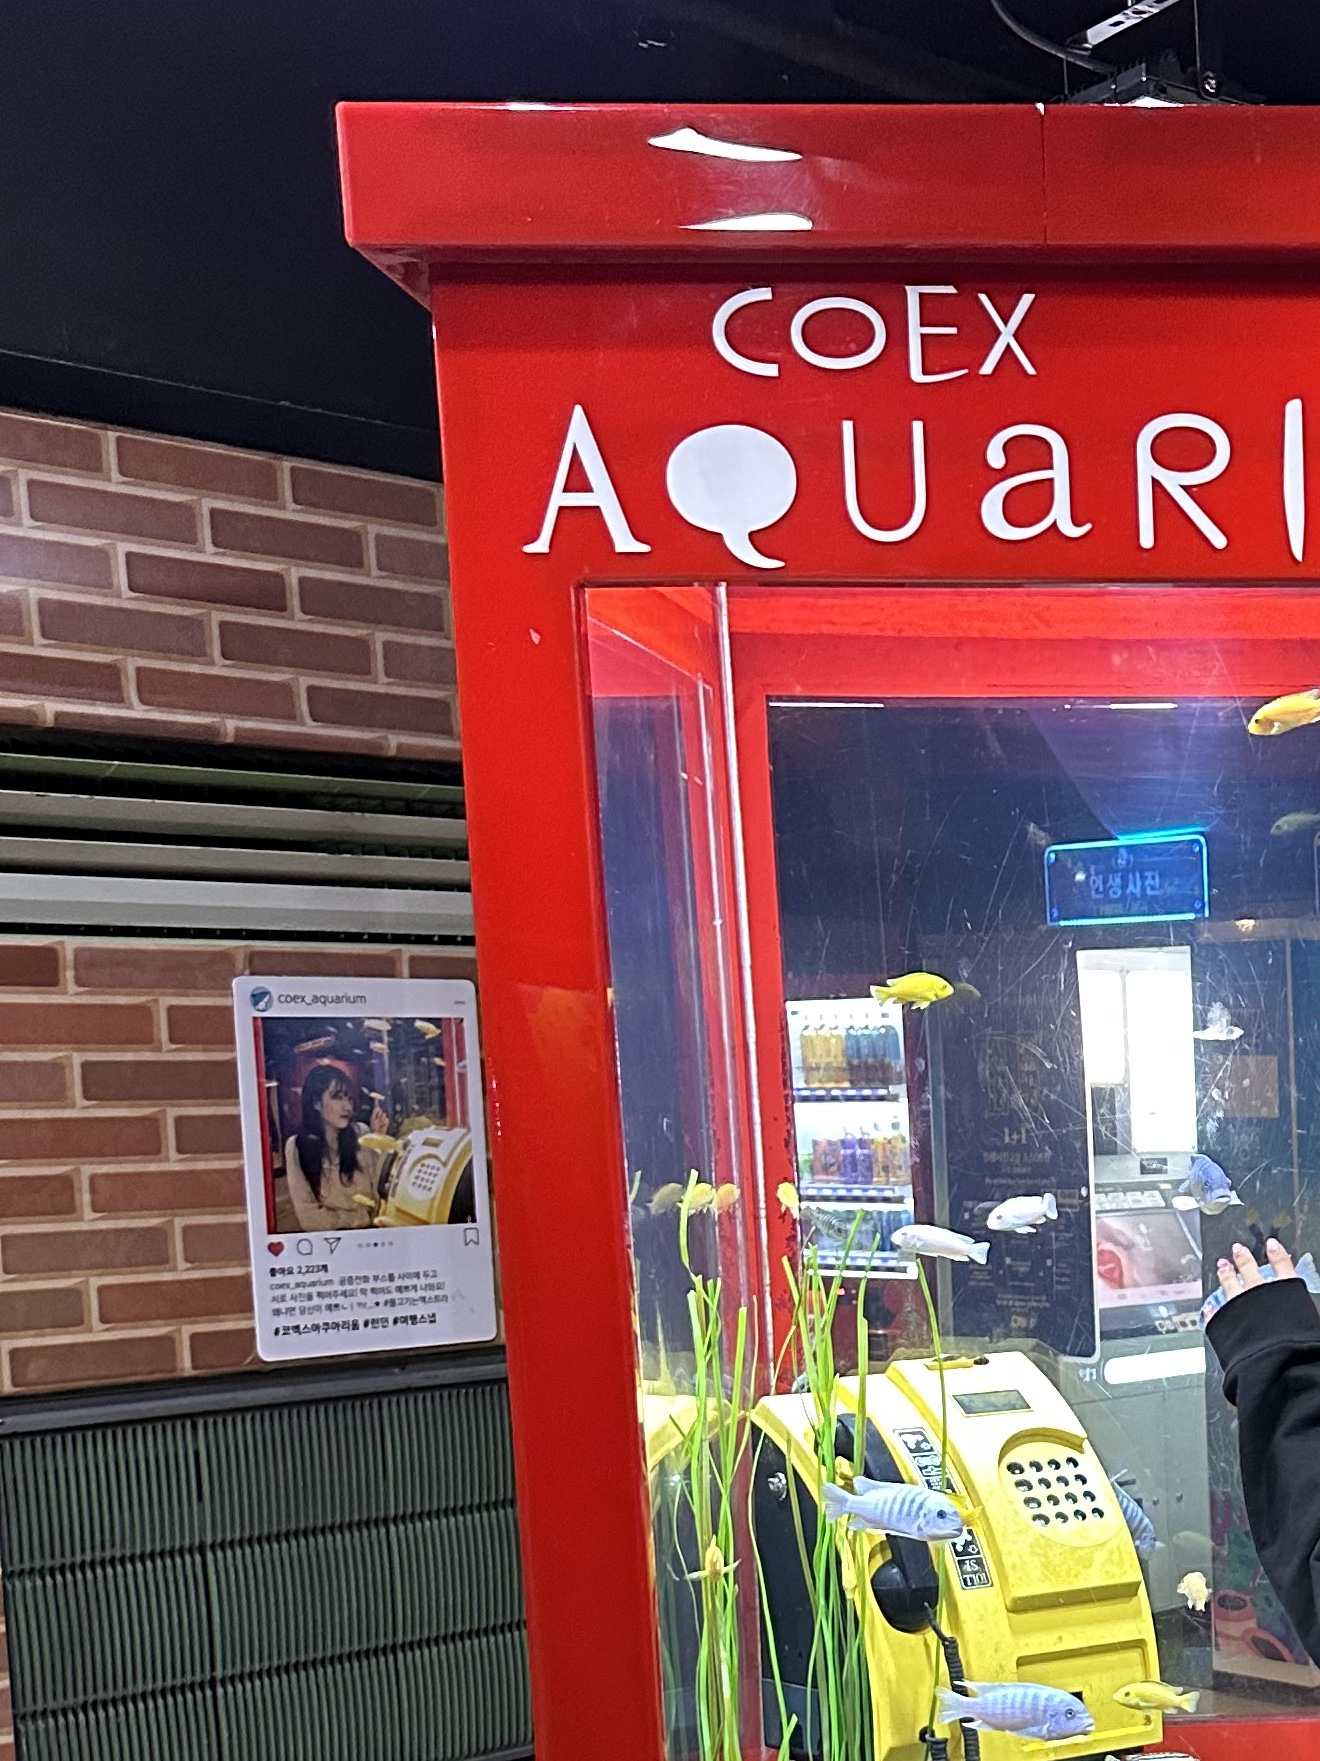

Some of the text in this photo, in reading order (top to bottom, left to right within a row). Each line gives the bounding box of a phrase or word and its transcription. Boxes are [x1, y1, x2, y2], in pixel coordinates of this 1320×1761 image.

[711, 284, 1038, 384] COEX
[1089, 869, 1162, 899] 인생사진
[278, 992, 367, 1006] coex_aquarium
[274, 1319, 360, 1337] #코엑스아쿠아리움
